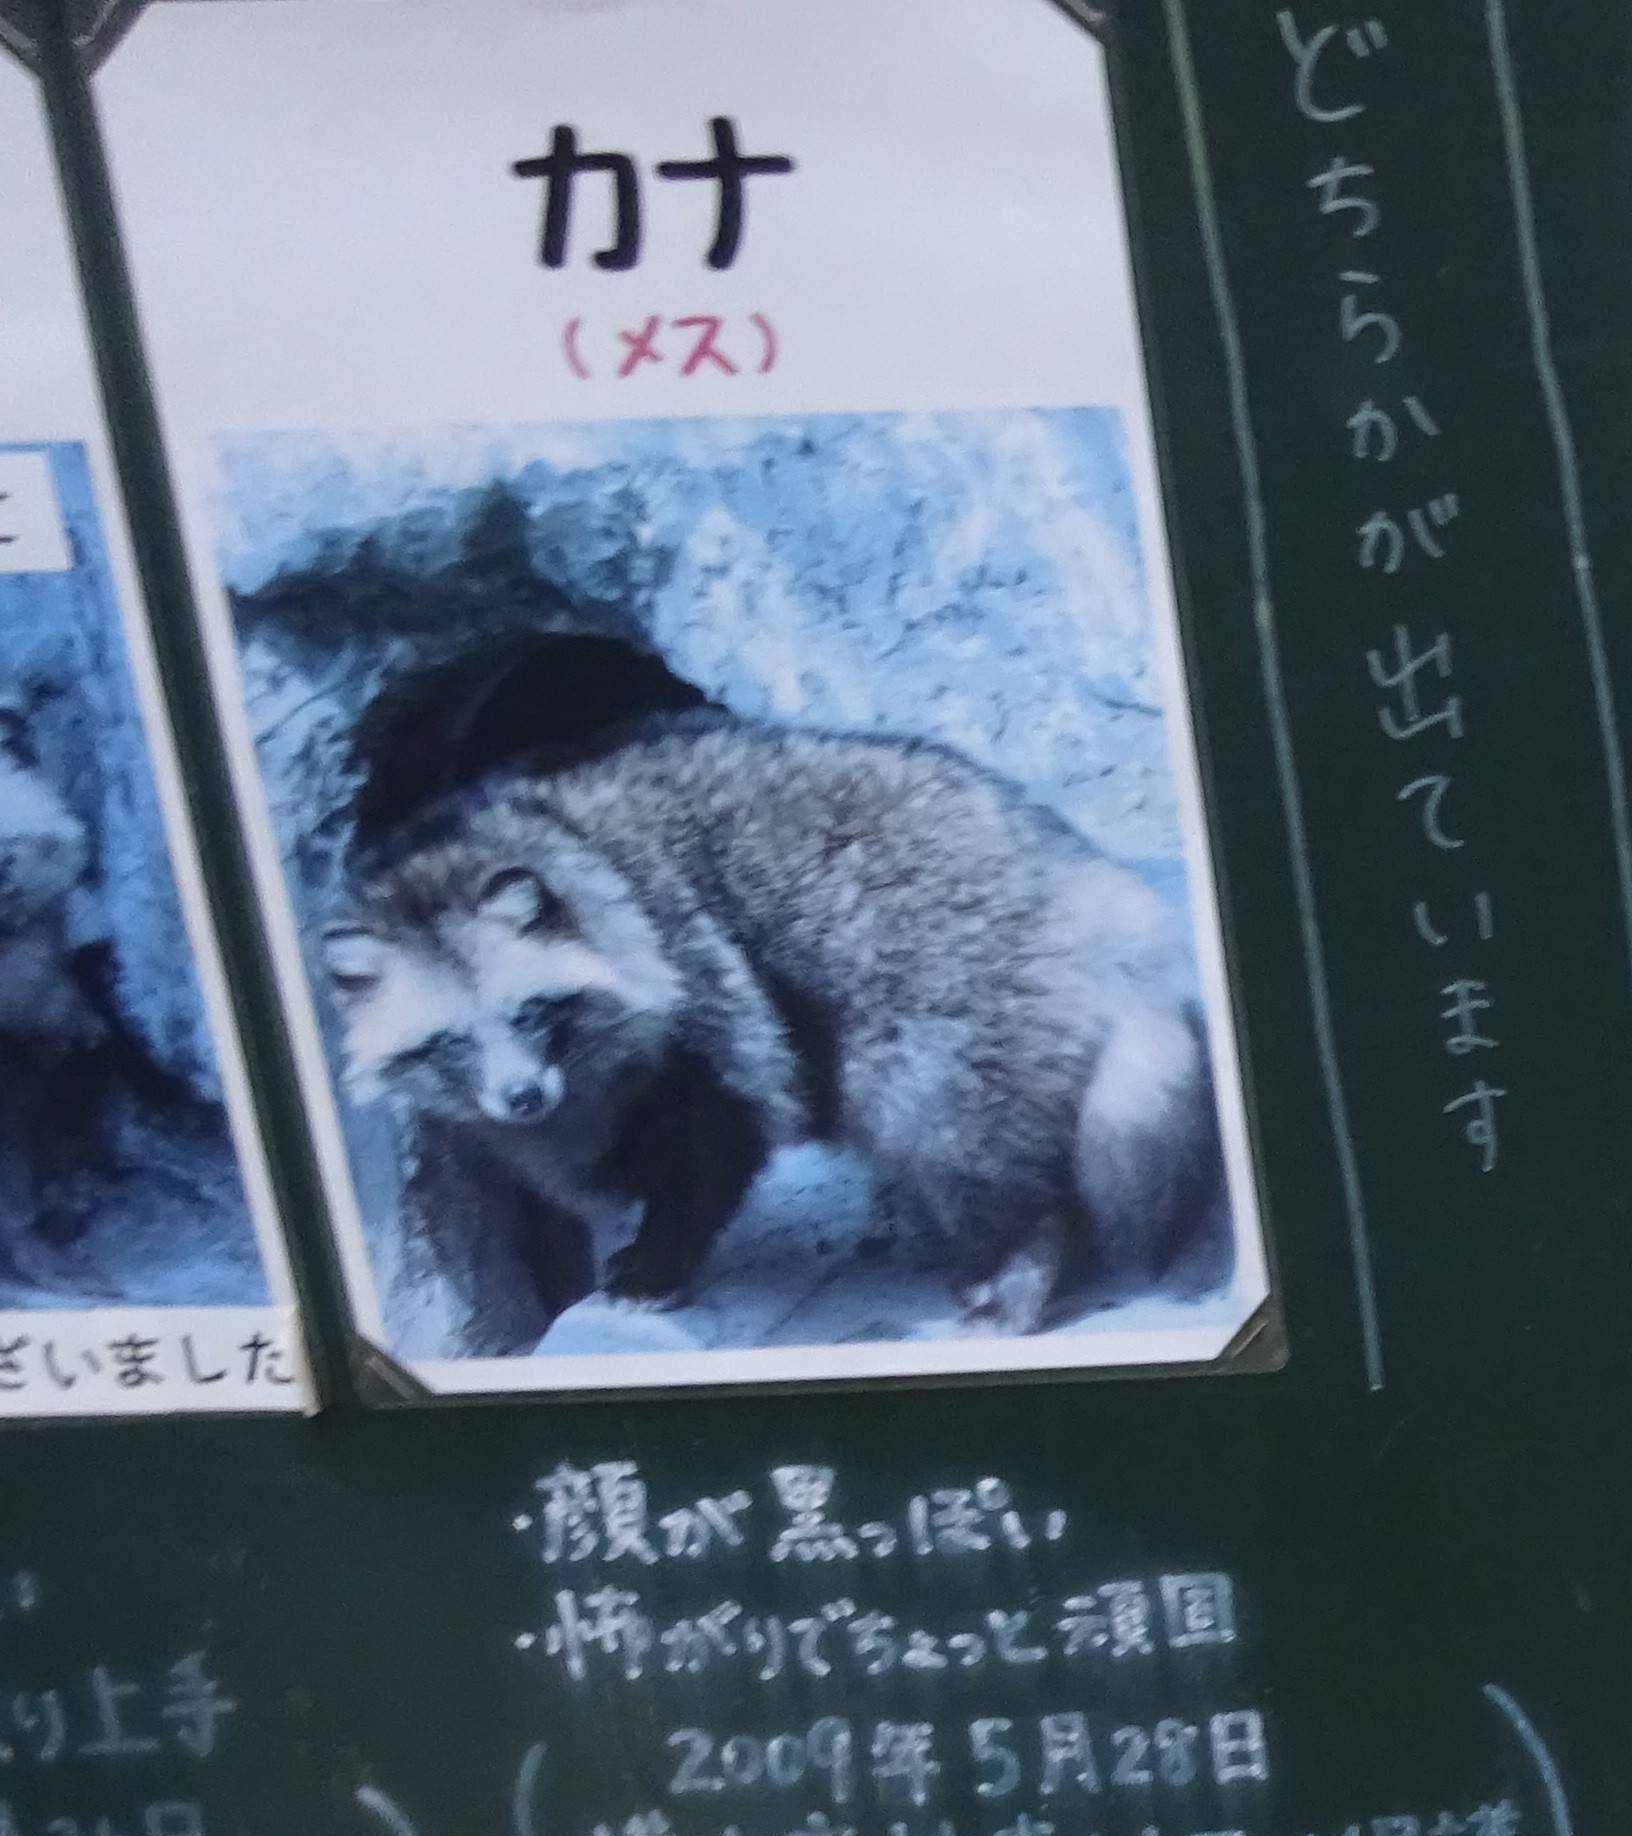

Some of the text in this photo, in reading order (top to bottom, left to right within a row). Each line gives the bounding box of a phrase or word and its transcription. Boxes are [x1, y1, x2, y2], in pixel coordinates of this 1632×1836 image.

[508, 112, 797, 273] カナ
[561, 312, 781, 379] (メス)
[1274, 8, 1508, 1172] どちらかが出ています
[0, 1648, 237, 1761] り上手
